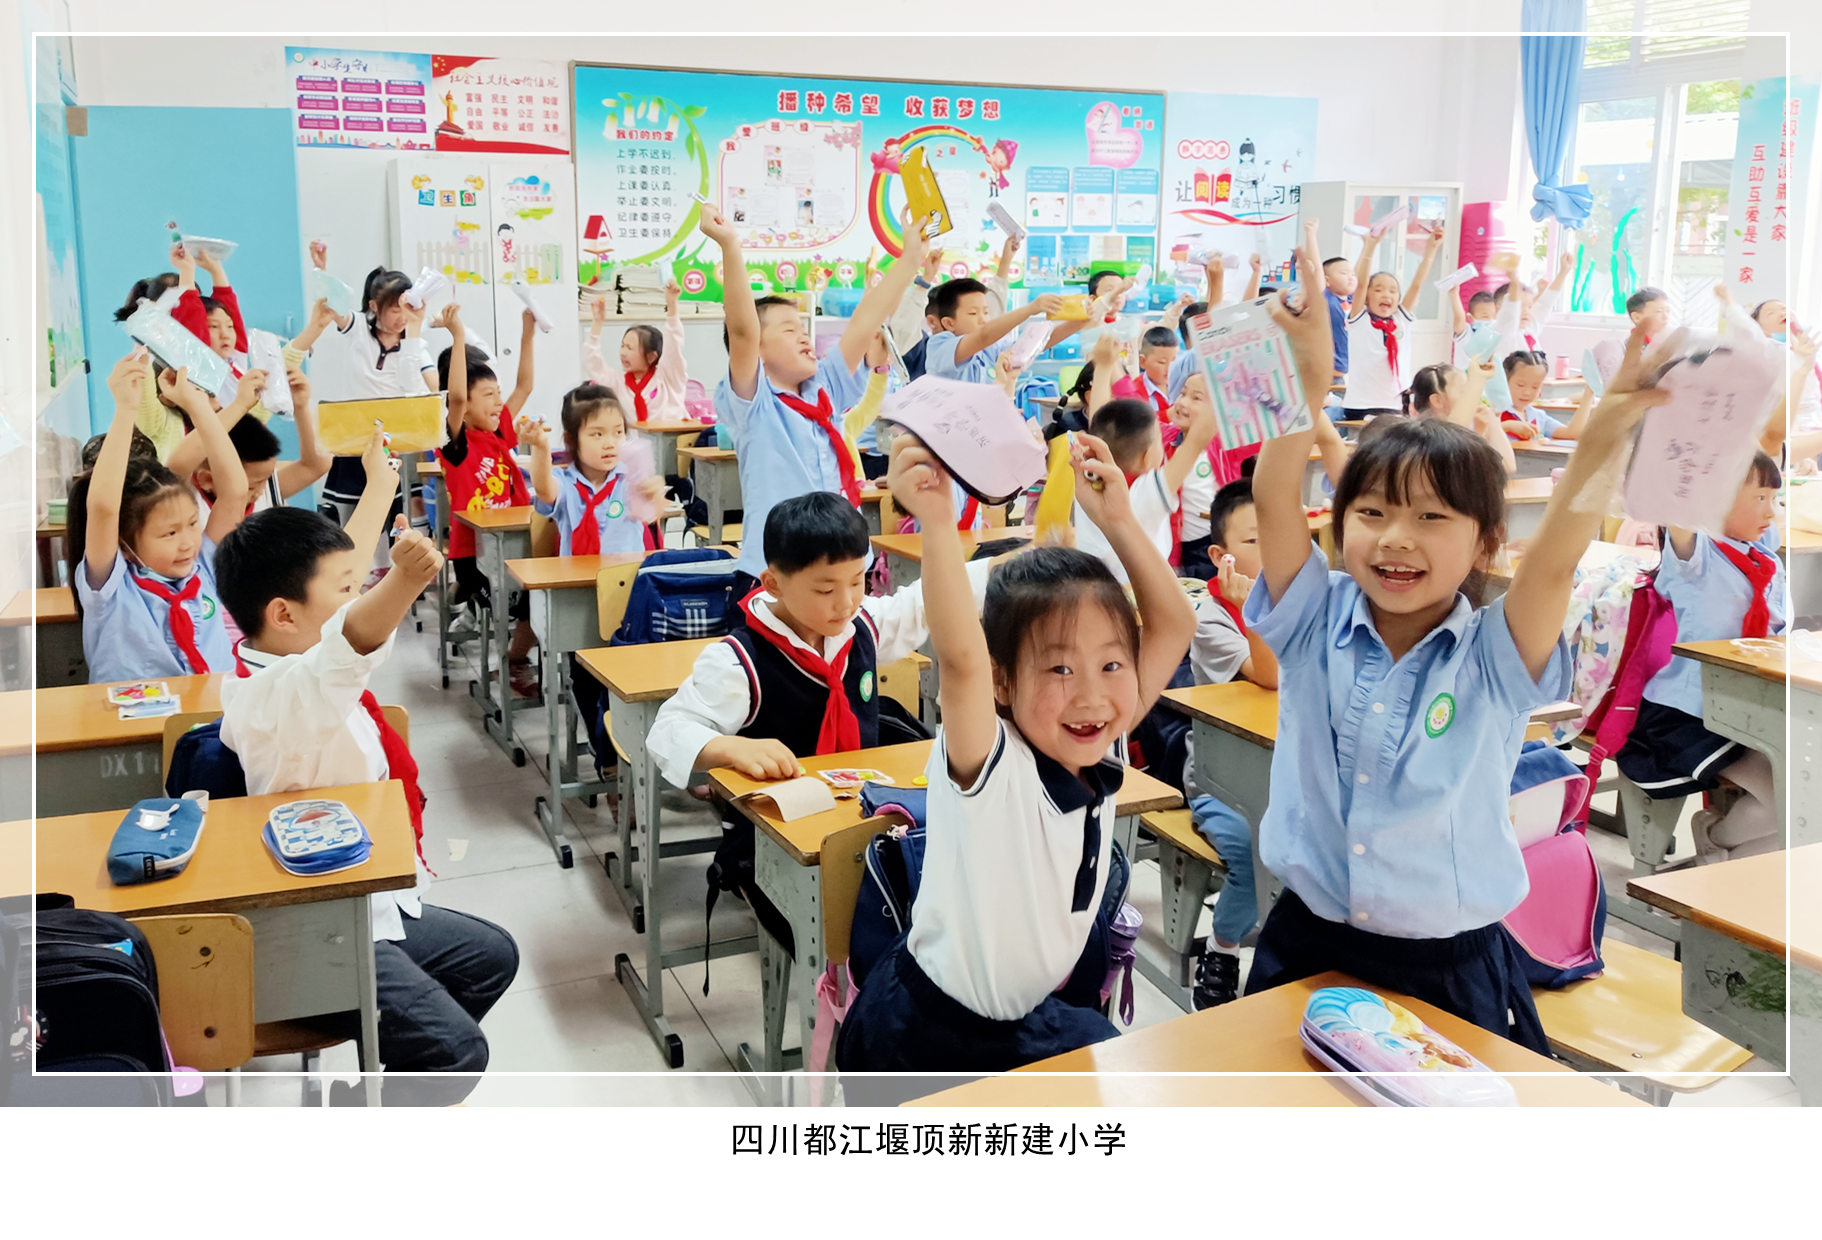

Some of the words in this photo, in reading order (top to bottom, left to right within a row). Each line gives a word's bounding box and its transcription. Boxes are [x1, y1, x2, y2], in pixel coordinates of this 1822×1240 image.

[778, 90, 880, 115] 播种希望
[904, 96, 1000, 119] 收获梦想
[616, 129, 674, 142] 我们的约定
[1738, 144, 1767, 284] 互助互爱是一家
